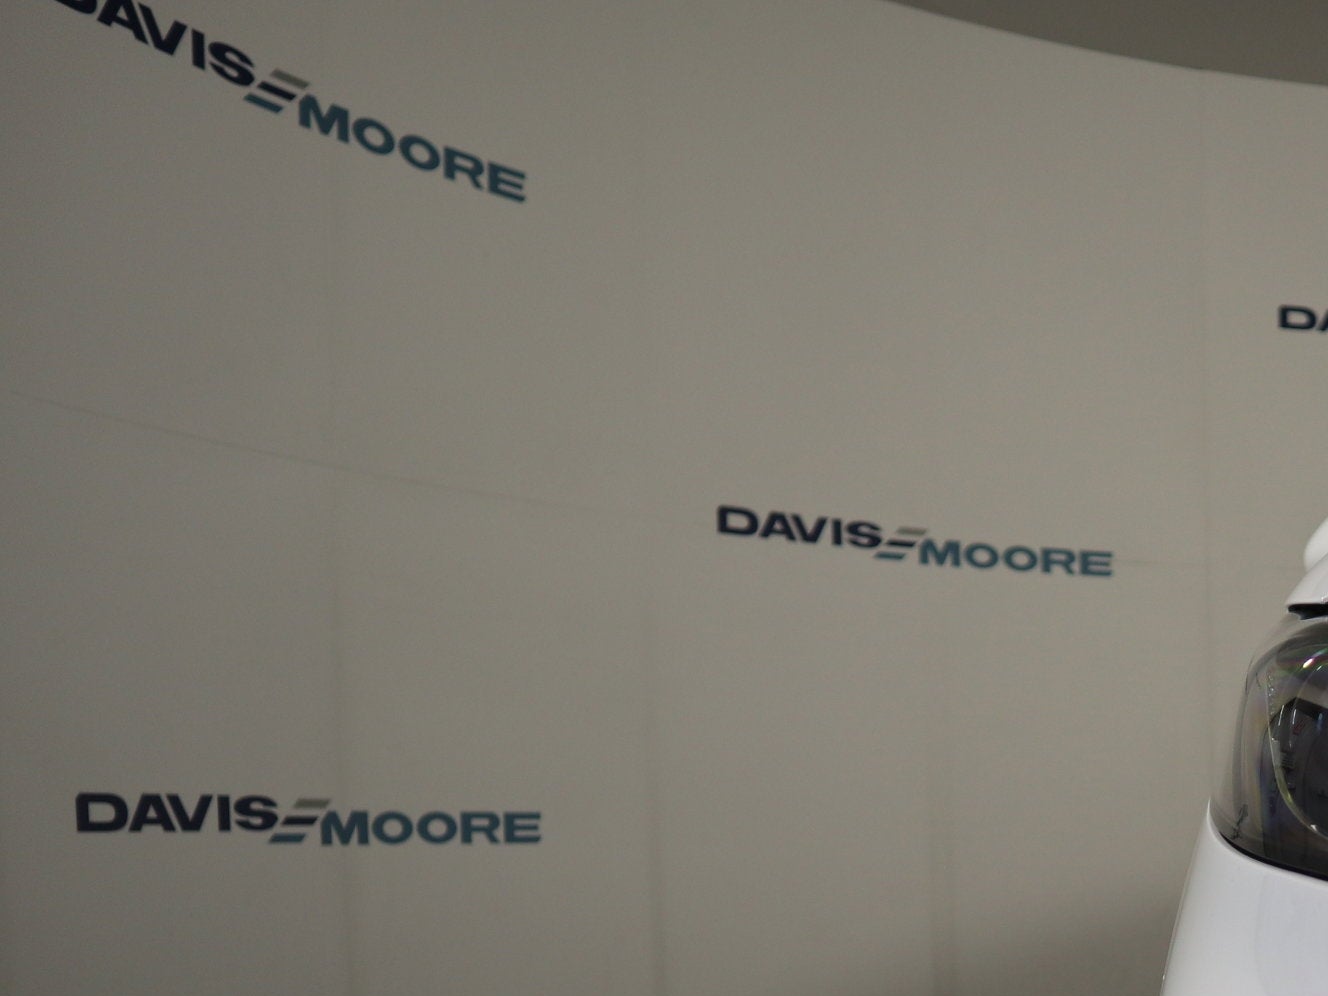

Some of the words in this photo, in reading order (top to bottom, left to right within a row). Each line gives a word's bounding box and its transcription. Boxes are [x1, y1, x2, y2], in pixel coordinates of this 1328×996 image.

[54, 0, 256, 87] AVIS
[298, 94, 526, 203] MOORE
[716, 505, 883, 549] DAVIS
[918, 538, 1113, 577] MOORE
[75, 792, 279, 833] DAVIS
[320, 811, 541, 846] MOORE
